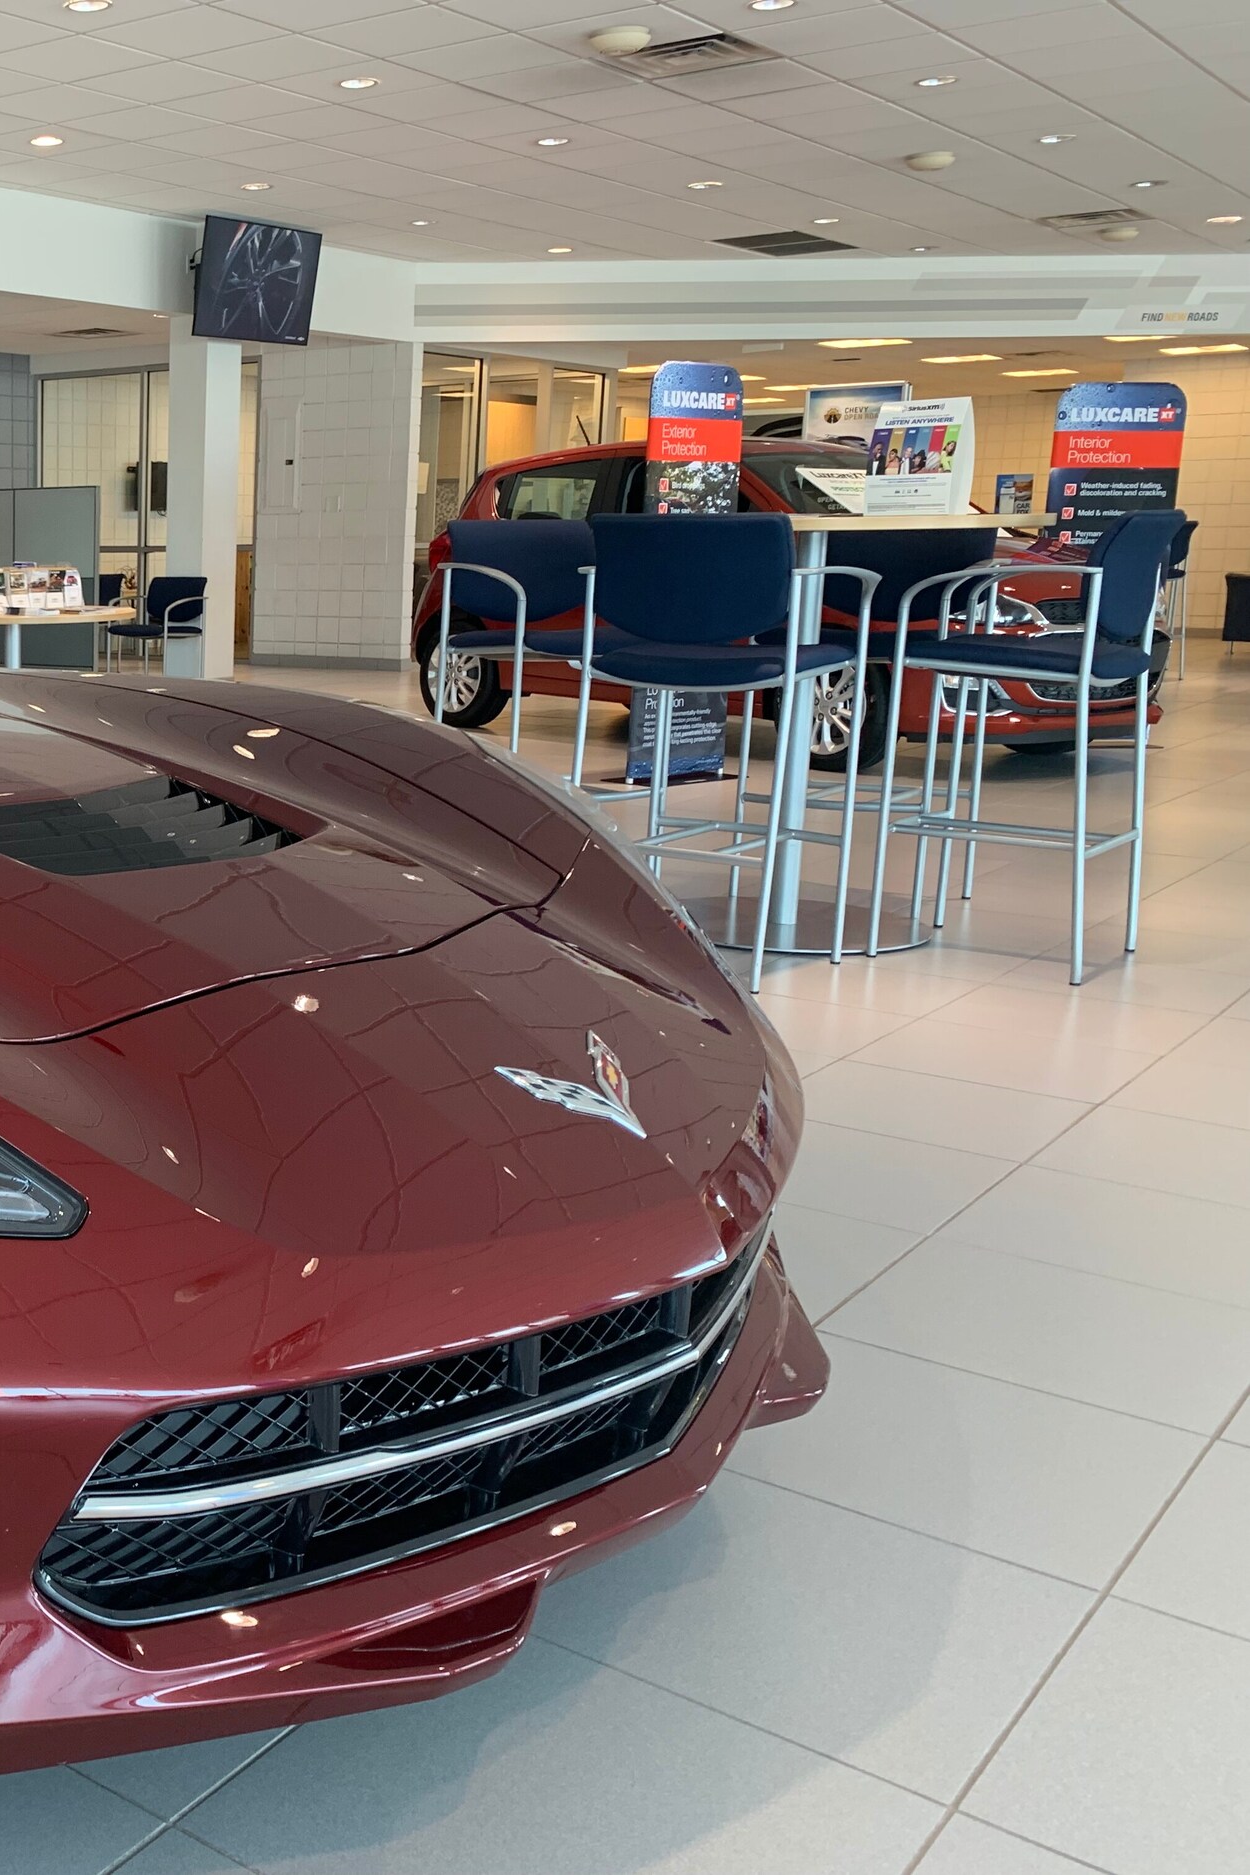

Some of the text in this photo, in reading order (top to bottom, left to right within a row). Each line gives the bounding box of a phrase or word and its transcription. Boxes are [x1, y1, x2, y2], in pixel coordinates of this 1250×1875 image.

[1141, 312, 1164, 322] FIND
[1187, 311, 1219, 321] ROADS
[844, 406, 869, 414] CHEVY
[864, 412, 879, 420] ROA
[885, 418, 910, 426] LISTEN
[910, 416, 955, 425] ANYWHERE
[662, 423, 697, 439] Exterior
[1069, 435, 1113, 449] Interior
[661, 440, 707, 456] Protection
[1067, 450, 1131, 464] Protection
[1140, 482, 1163, 491] fading,
[1138, 489, 1167, 497] cracking
